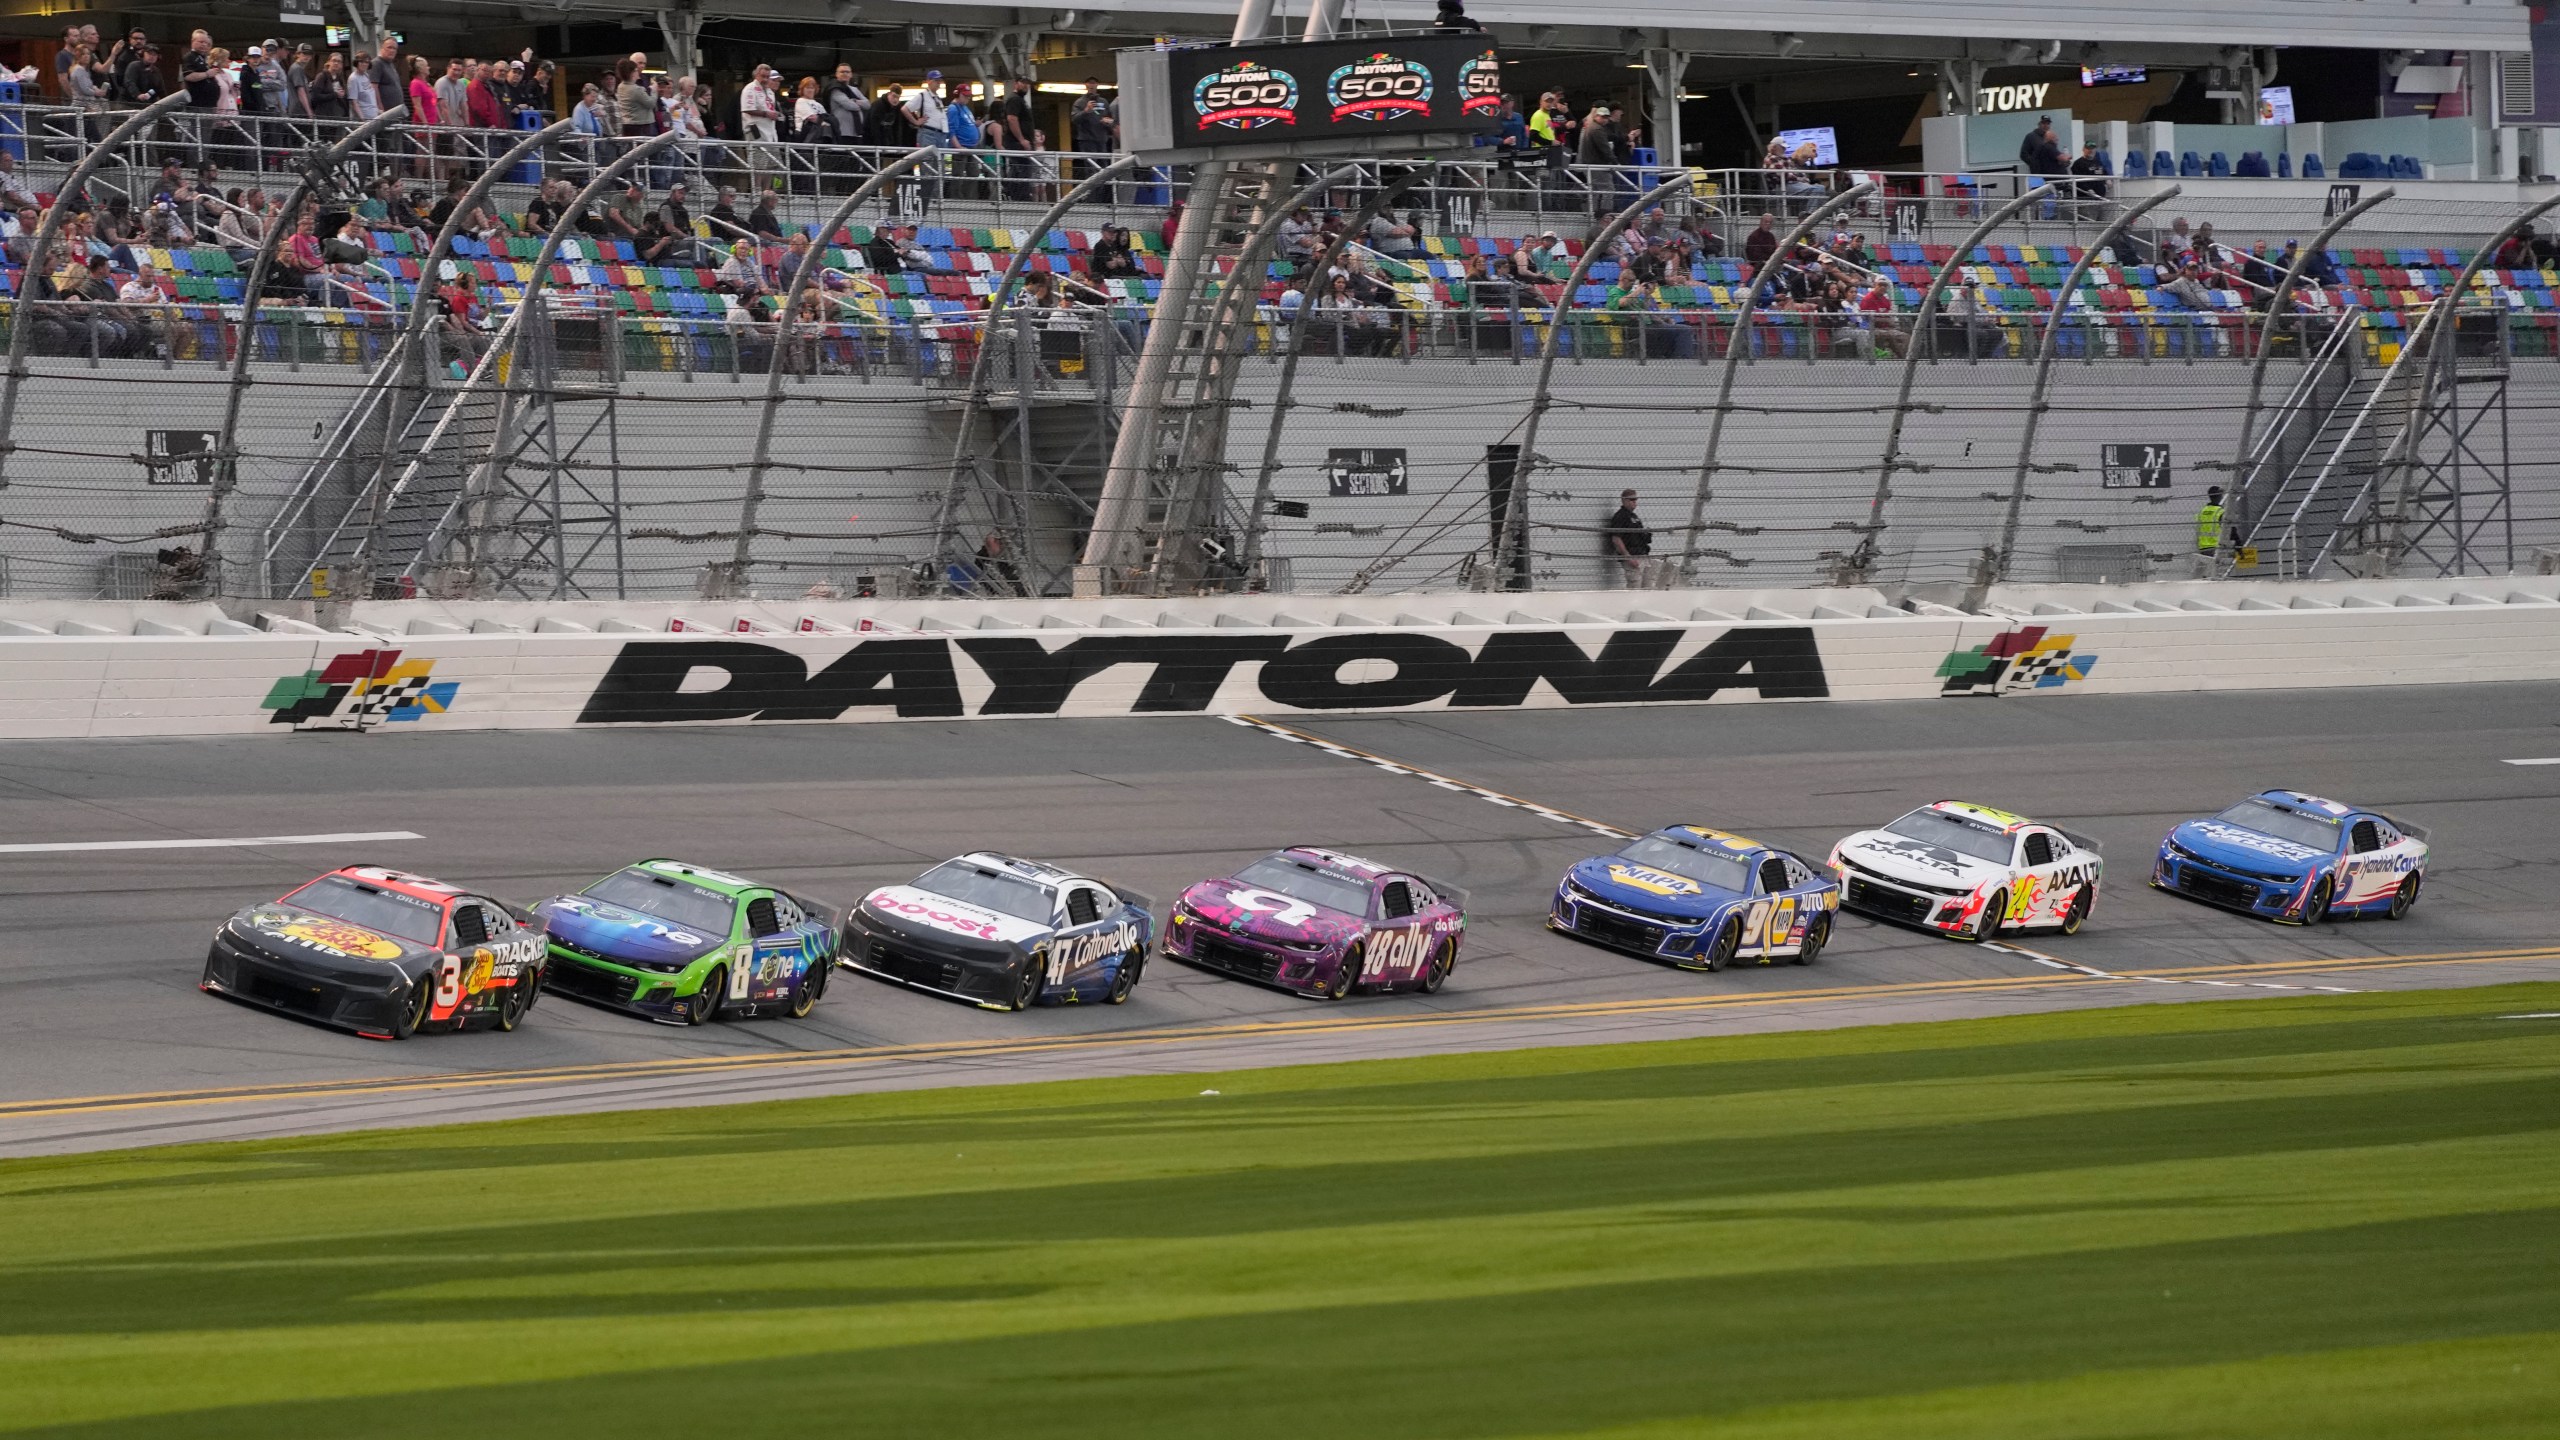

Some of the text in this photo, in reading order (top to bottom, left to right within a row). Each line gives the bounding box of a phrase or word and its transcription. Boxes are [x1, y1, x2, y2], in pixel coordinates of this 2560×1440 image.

[1220, 72, 1270, 84] DAYTONA
[1354, 63, 1405, 75] DAYTONA
[1206, 83, 1288, 108] 500
[1339, 75, 1423, 99] 500
[896, 184, 922, 221] 145
[1448, 196, 1472, 233] 144
[1895, 205, 1918, 241] 143
[152, 432, 170, 456] ALL
[2105, 446, 2119, 465] ALL
[1349, 473, 1390, 494] SECTIONS
[576, 627, 1829, 723] DAYTONA
[1969, 822, 2002, 836] BYRON
[2295, 810, 2333, 825] LARSON
[1703, 847, 1742, 862] ELLIOT
[1854, 842, 1961, 878] AXALTA
[1318, 868, 1365, 886] BOWMAN
[1620, 866, 1689, 893] NAPA
[380, 890, 441, 912] A. DILLON
[1799, 892, 1824, 911] AUTO
[2005, 877, 2036, 920] 24
[871, 893, 998, 939] boost
[1435, 917, 1448, 931] do
[1741, 902, 1770, 945] 9
[1775, 910, 1793, 931] NAPA
[1074, 920, 1138, 969] Cottonelle
[1362, 929, 1394, 975] 48
[1389, 922, 1432, 980] ally
[491, 963, 518, 977] BOATS
[730, 944, 754, 1000] 8
[1046, 939, 1073, 985] 47
[437, 955, 461, 1007] 3
